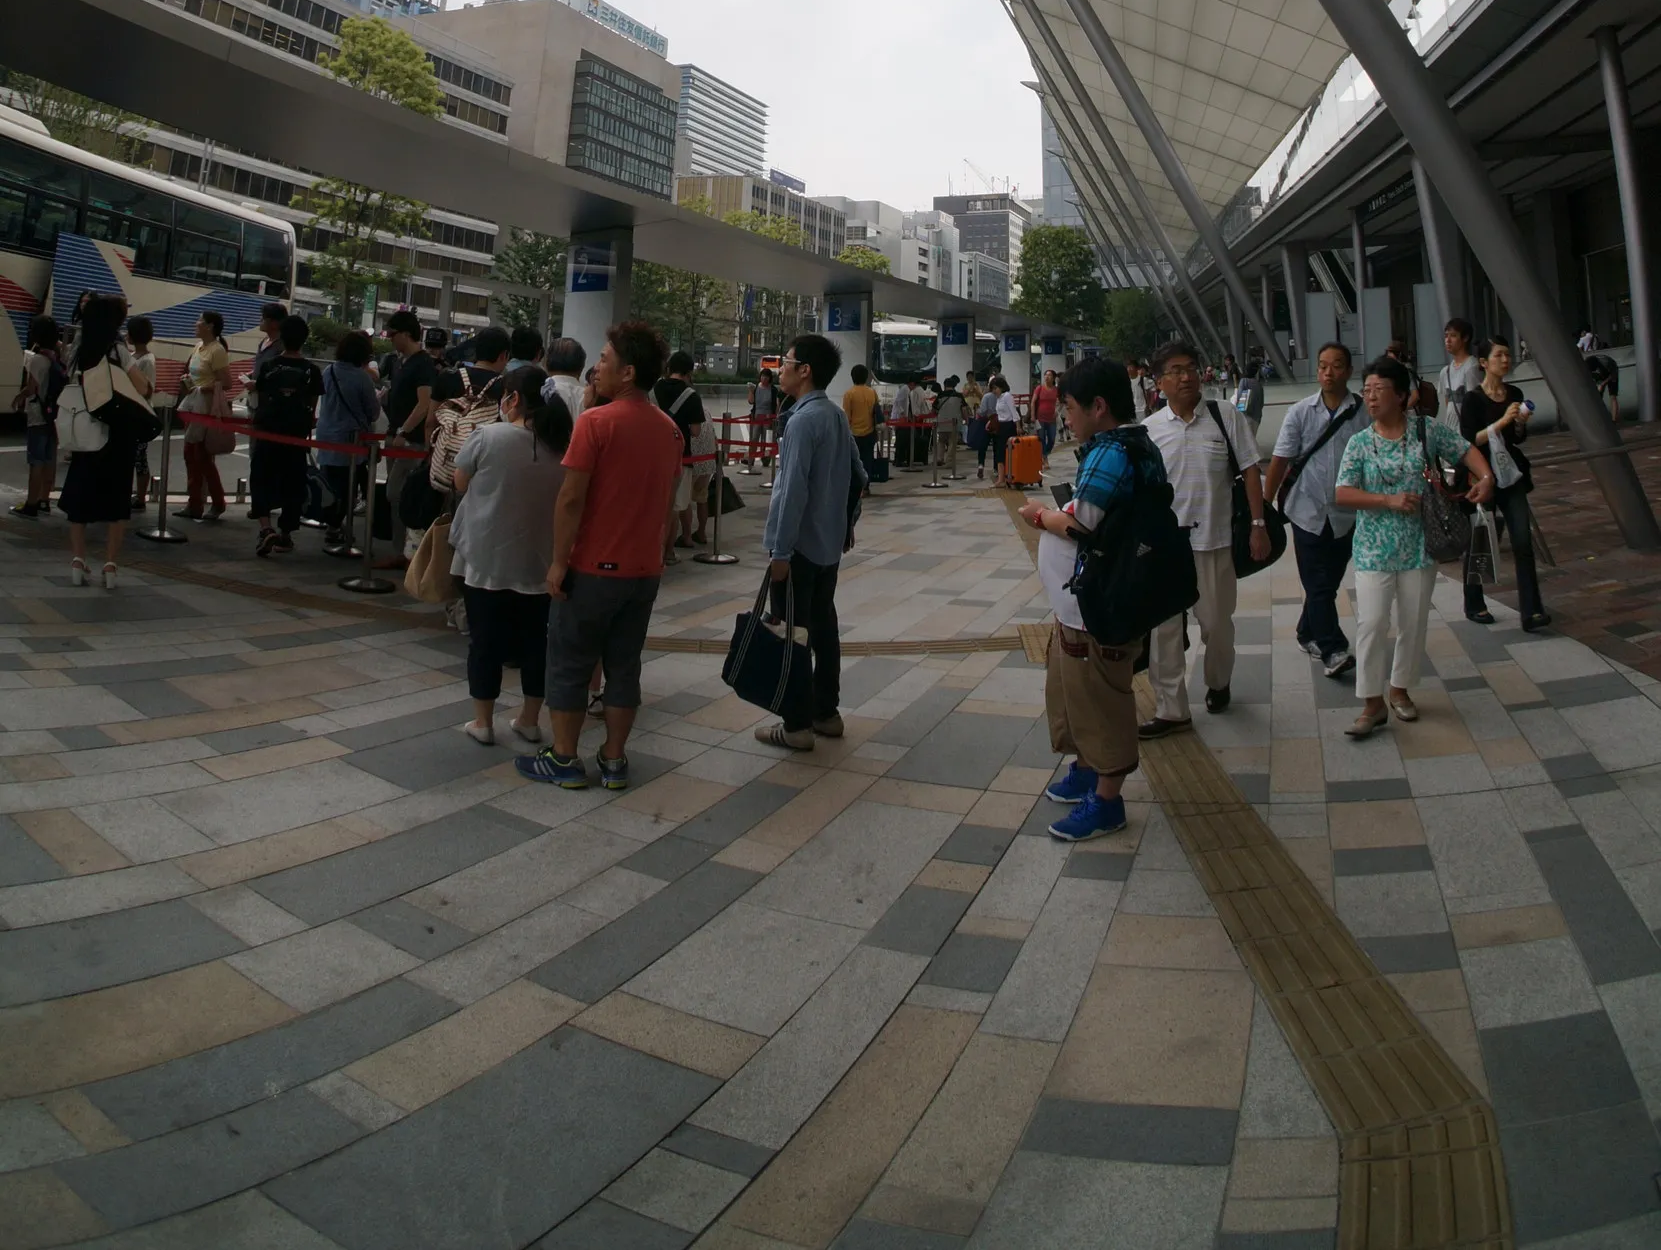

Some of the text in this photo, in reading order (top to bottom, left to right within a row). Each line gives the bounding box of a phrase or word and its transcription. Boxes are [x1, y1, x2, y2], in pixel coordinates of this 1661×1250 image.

[600, 6, 666, 53] 三井住友信託銀行
[577, 253, 588, 283] 2
[833, 307, 842, 327] 3
[945, 326, 953, 342] 4
[1008, 338, 1014, 350] 5
